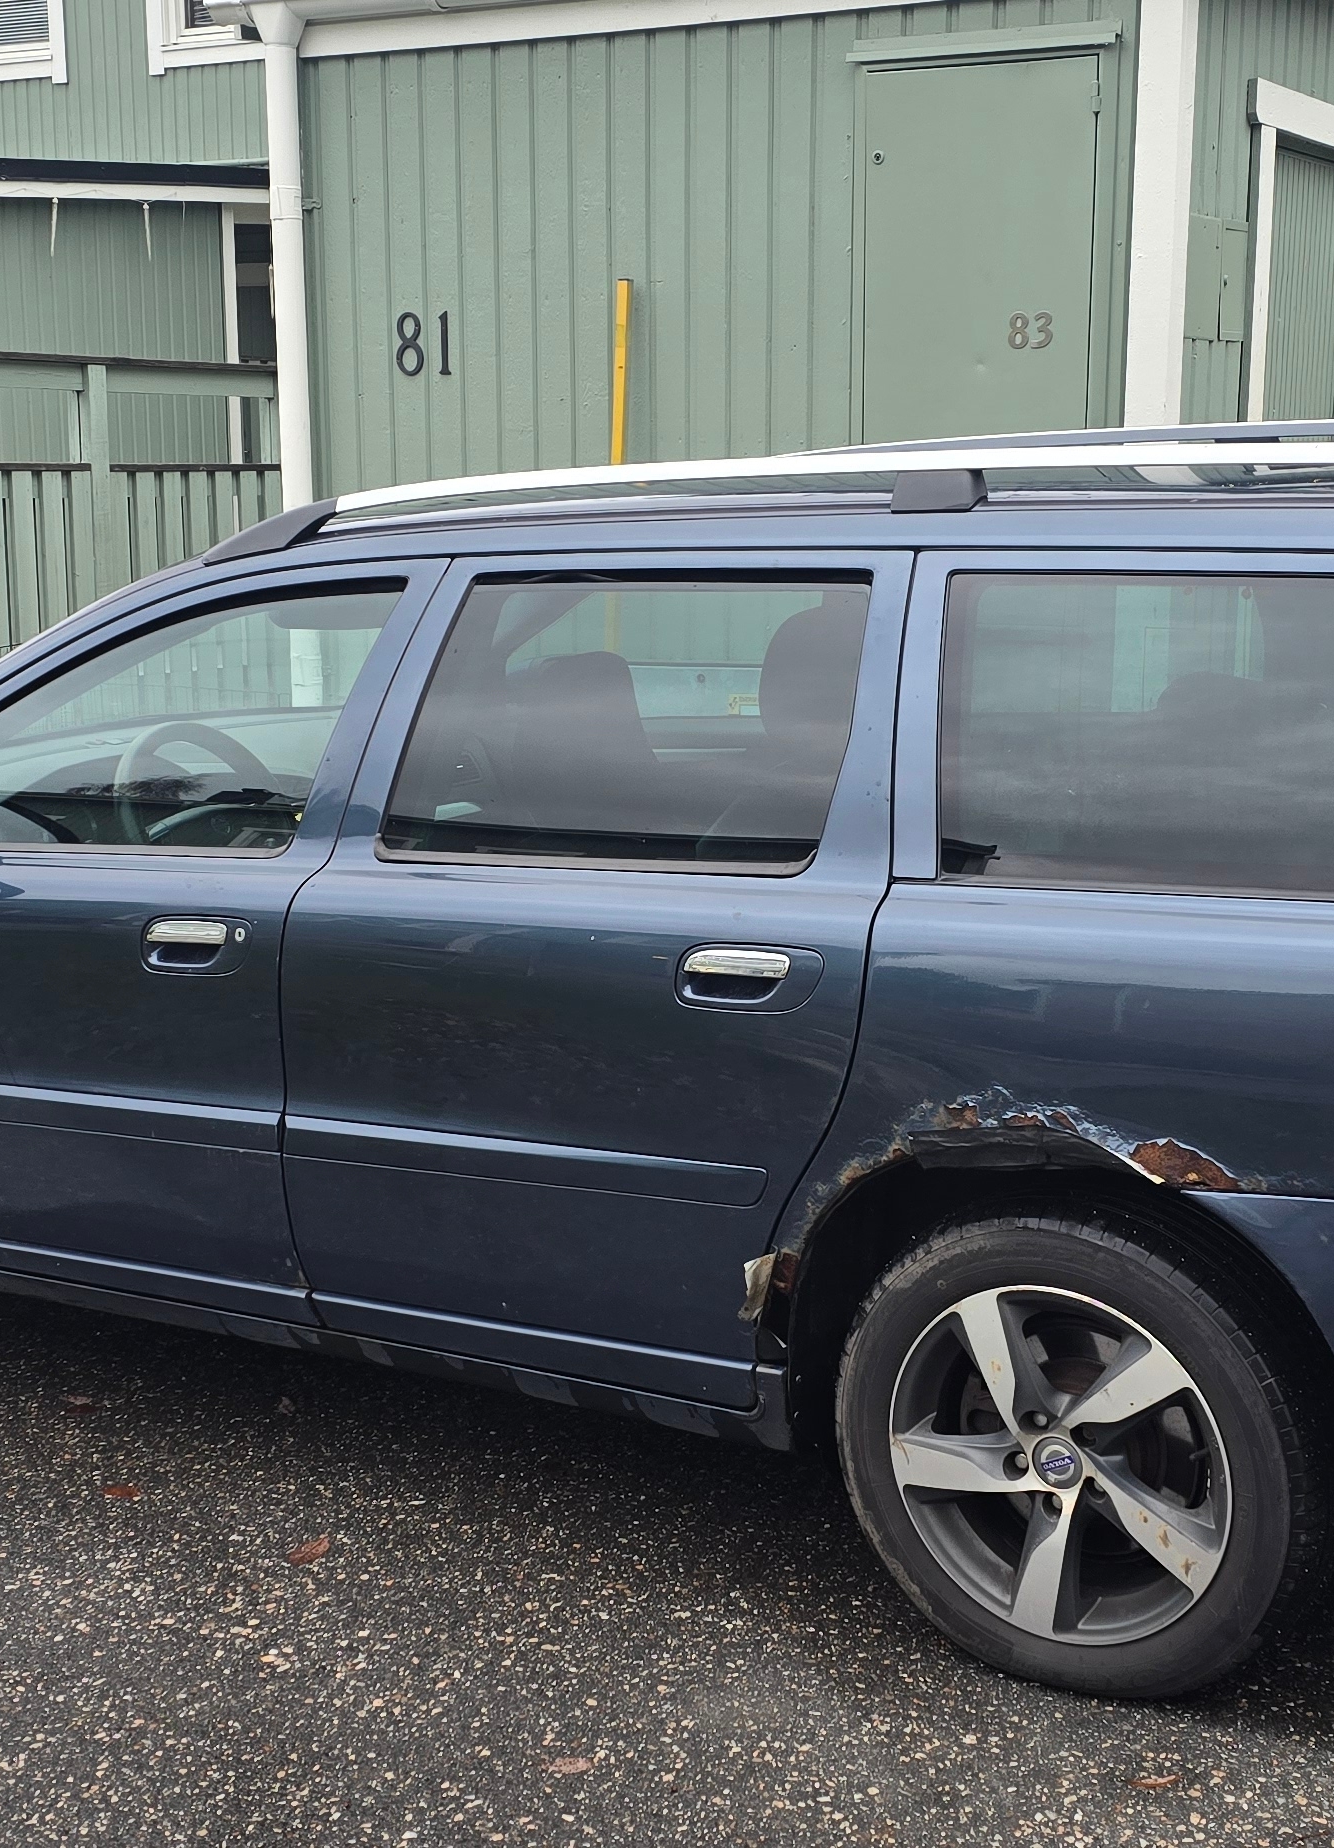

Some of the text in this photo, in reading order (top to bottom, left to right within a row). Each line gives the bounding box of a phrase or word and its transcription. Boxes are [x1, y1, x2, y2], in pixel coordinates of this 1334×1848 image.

[395, 310, 452, 377] 81
[1007, 311, 1054, 350] 83
[1043, 1457, 1072, 1470] VOLVO
